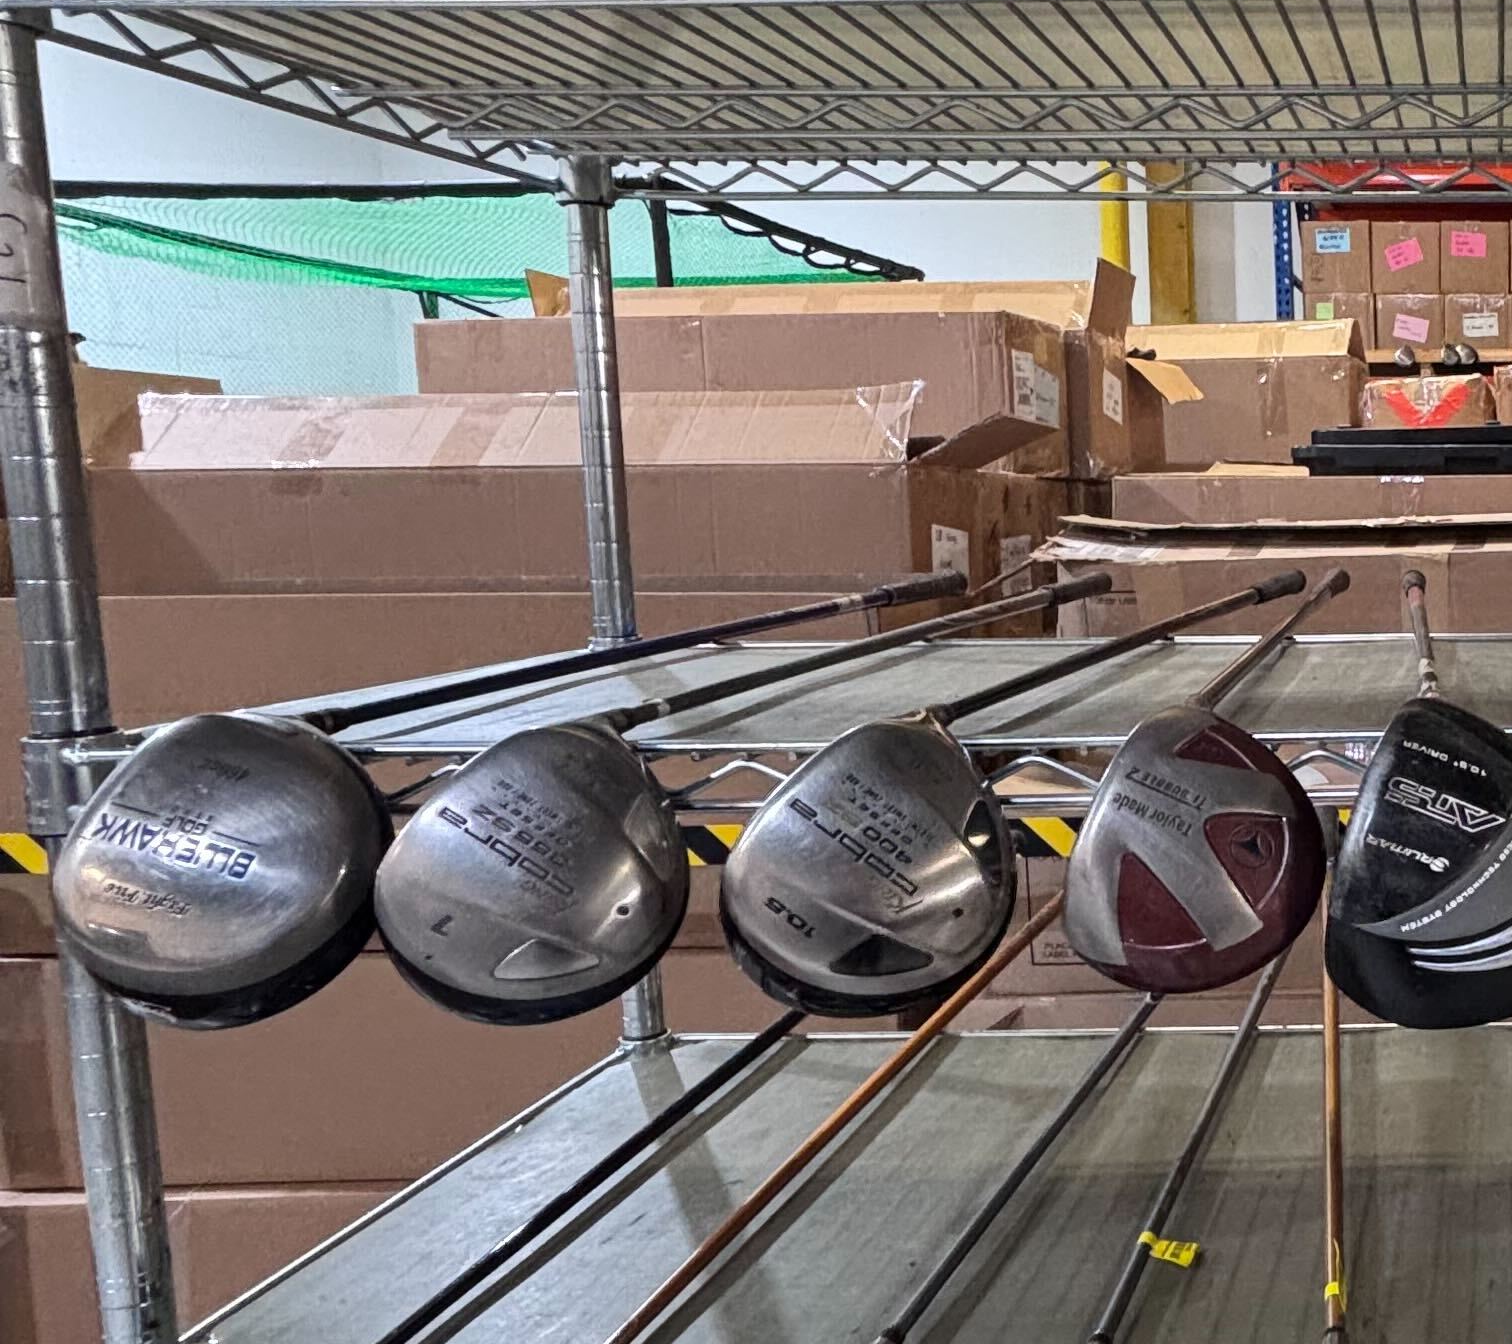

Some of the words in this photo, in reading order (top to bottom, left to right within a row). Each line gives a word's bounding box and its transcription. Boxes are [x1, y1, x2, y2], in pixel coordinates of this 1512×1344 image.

[1402, 739, 1449, 761] DRIVER
[162, 814, 209, 836] GOLF
[1112, 792, 1149, 820] Made
[1150, 799, 1193, 838] Taylor
[95, 812, 257, 880] BLUEHAWK
[438, 806, 575, 897] cobra
[790, 798, 919, 897] cobra
[1444, 861, 1501, 913] TECHNOLOGY
[1400, 907, 1443, 933] SYSTEM
